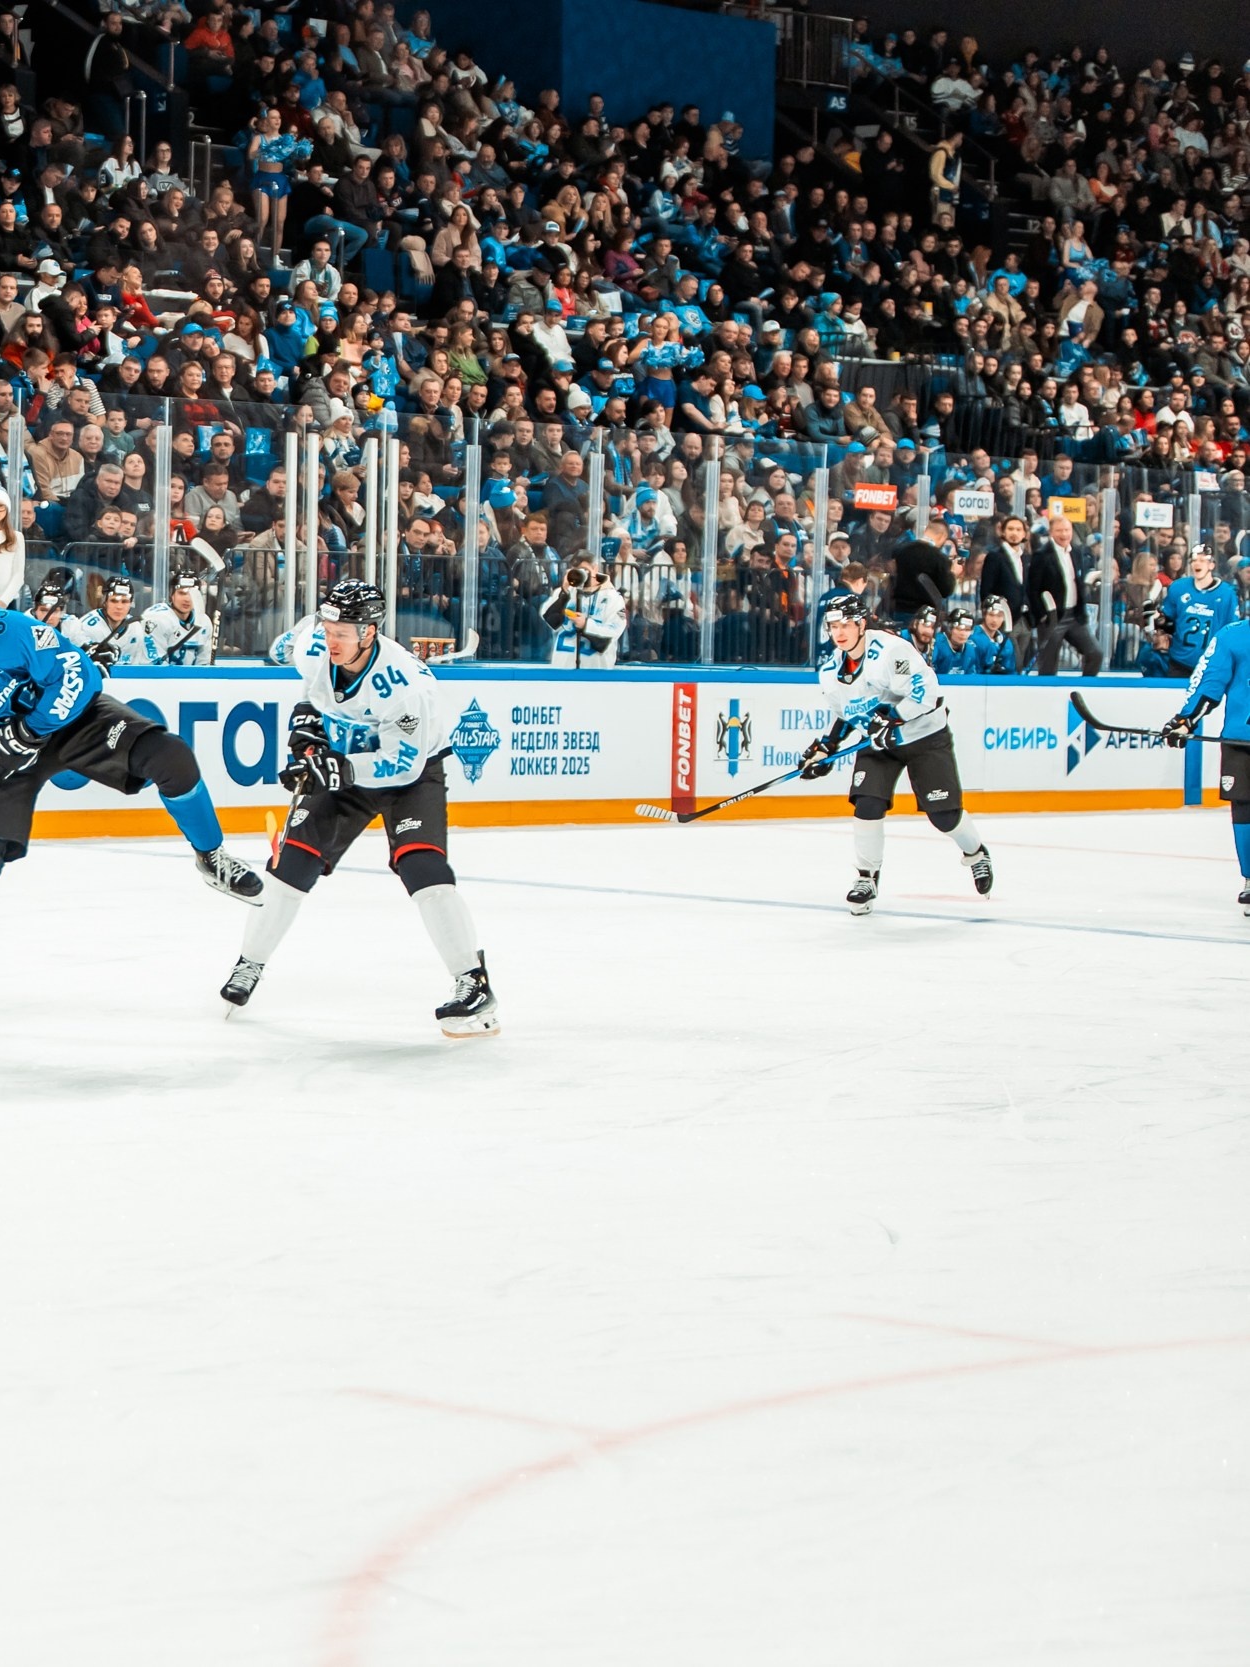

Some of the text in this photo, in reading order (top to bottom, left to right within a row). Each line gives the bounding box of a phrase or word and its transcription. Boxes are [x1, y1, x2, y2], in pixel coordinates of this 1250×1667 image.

[855, 488, 897, 506] FONBET
[1182, 616, 1211, 649] 21
[371, 665, 409, 699] 94
[511, 705, 562, 725] ФОНБЕТ
[511, 731, 600, 753] НЕДЕЛЯ ЗВЕЗД
[677, 688, 693, 792] FONBET
[983, 727, 1058, 750] СИБИРЬ
[1105, 731, 1166, 749] АРЕНА
[510, 756, 590, 776] ХОККЕЯ 2025
